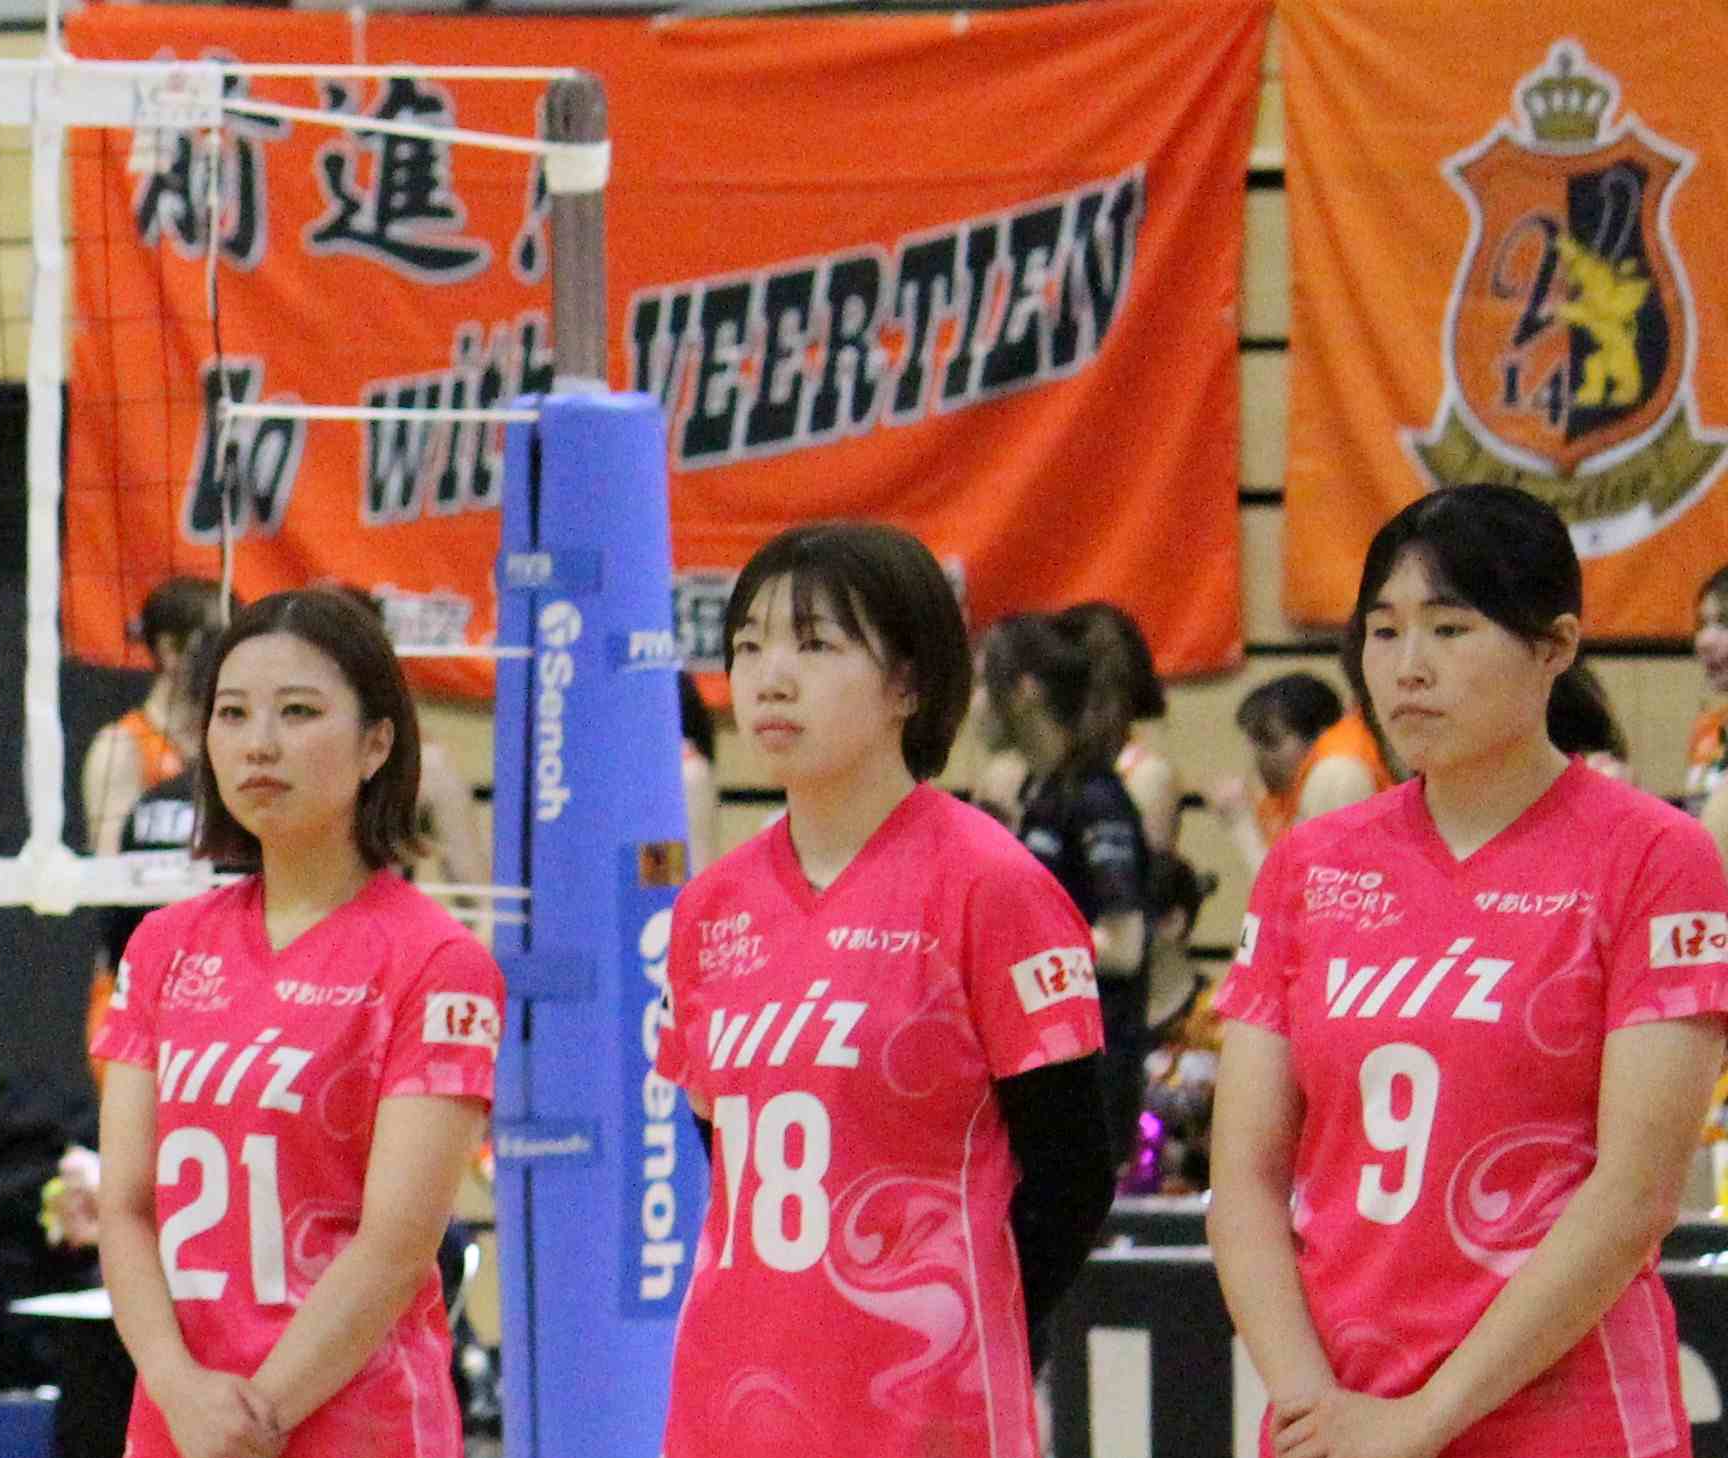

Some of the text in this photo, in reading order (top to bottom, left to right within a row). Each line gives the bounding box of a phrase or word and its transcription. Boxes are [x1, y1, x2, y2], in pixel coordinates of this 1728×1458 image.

[625, 160, 1146, 473] VEERTIEN
[155, 1126, 289, 1306] 21
[712, 1091, 832, 1274] 18
[1356, 1042, 1441, 1226] 9
